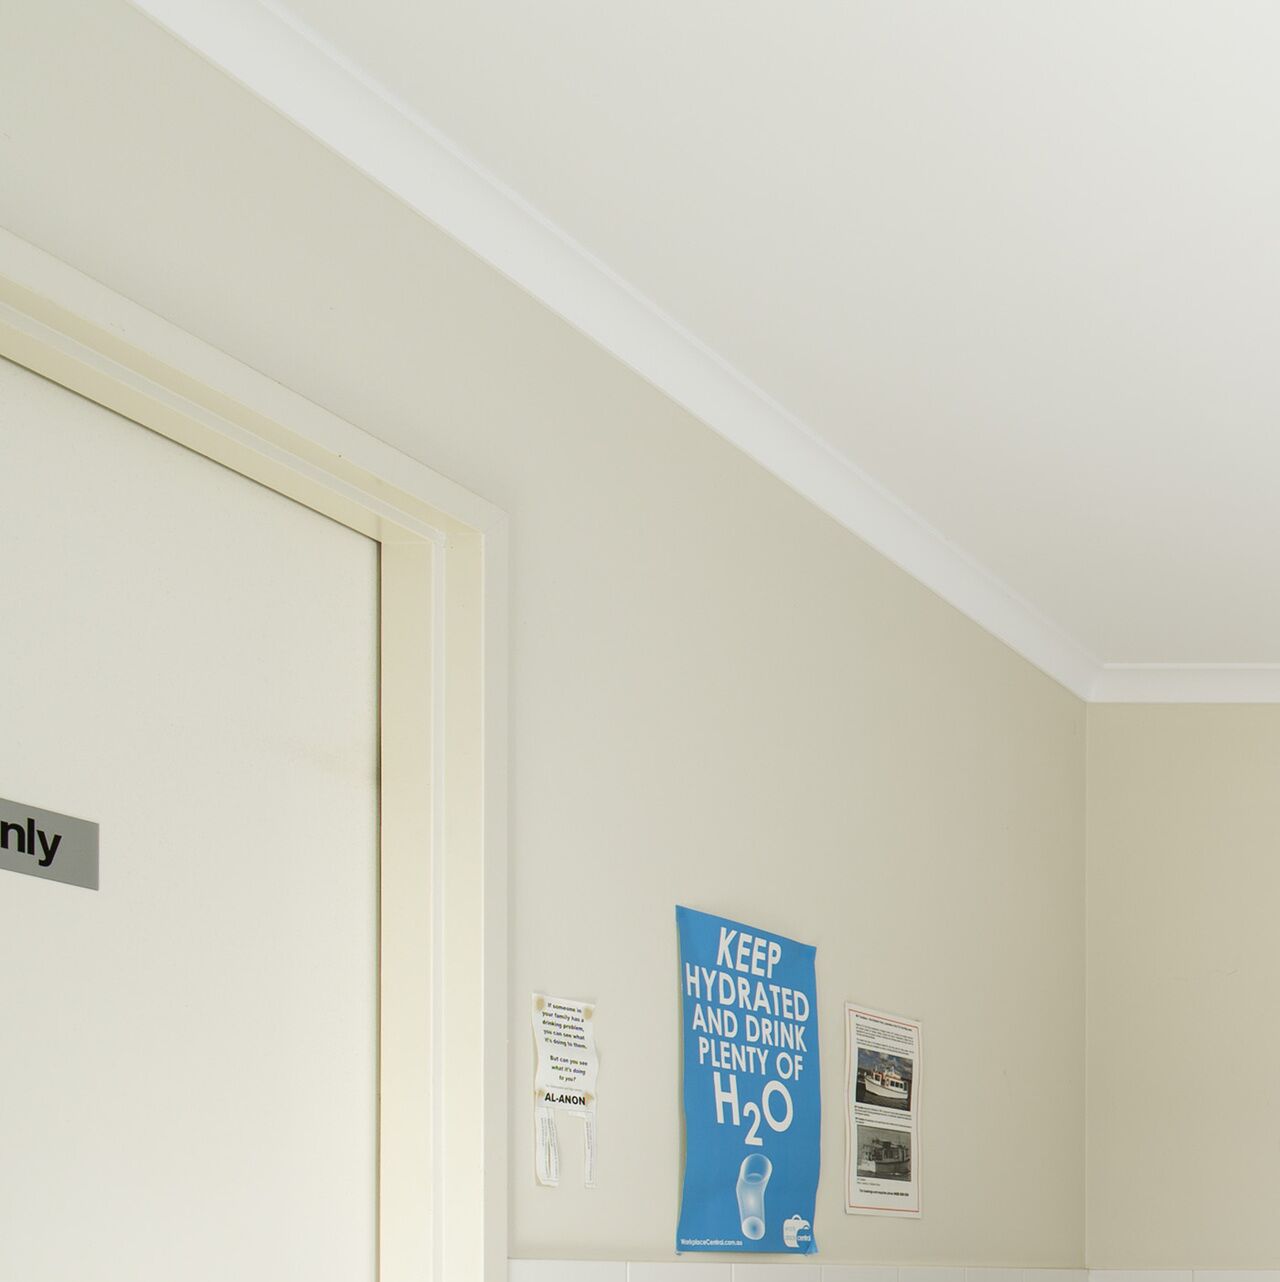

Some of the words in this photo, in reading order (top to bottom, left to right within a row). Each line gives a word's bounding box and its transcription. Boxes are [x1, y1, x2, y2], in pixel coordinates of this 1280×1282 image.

[717, 926, 781, 978] KEEP
[686, 963, 809, 1022] HYDRATED
[693, 1004, 738, 1038] AND
[745, 1014, 807, 1052] DRINK
[699, 1037, 768, 1075] PLENTY
[776, 1052, 803, 1080] OF
[545, 1093, 585, 1105] AL-ANON
[713, 1072, 793, 1146] H2O
